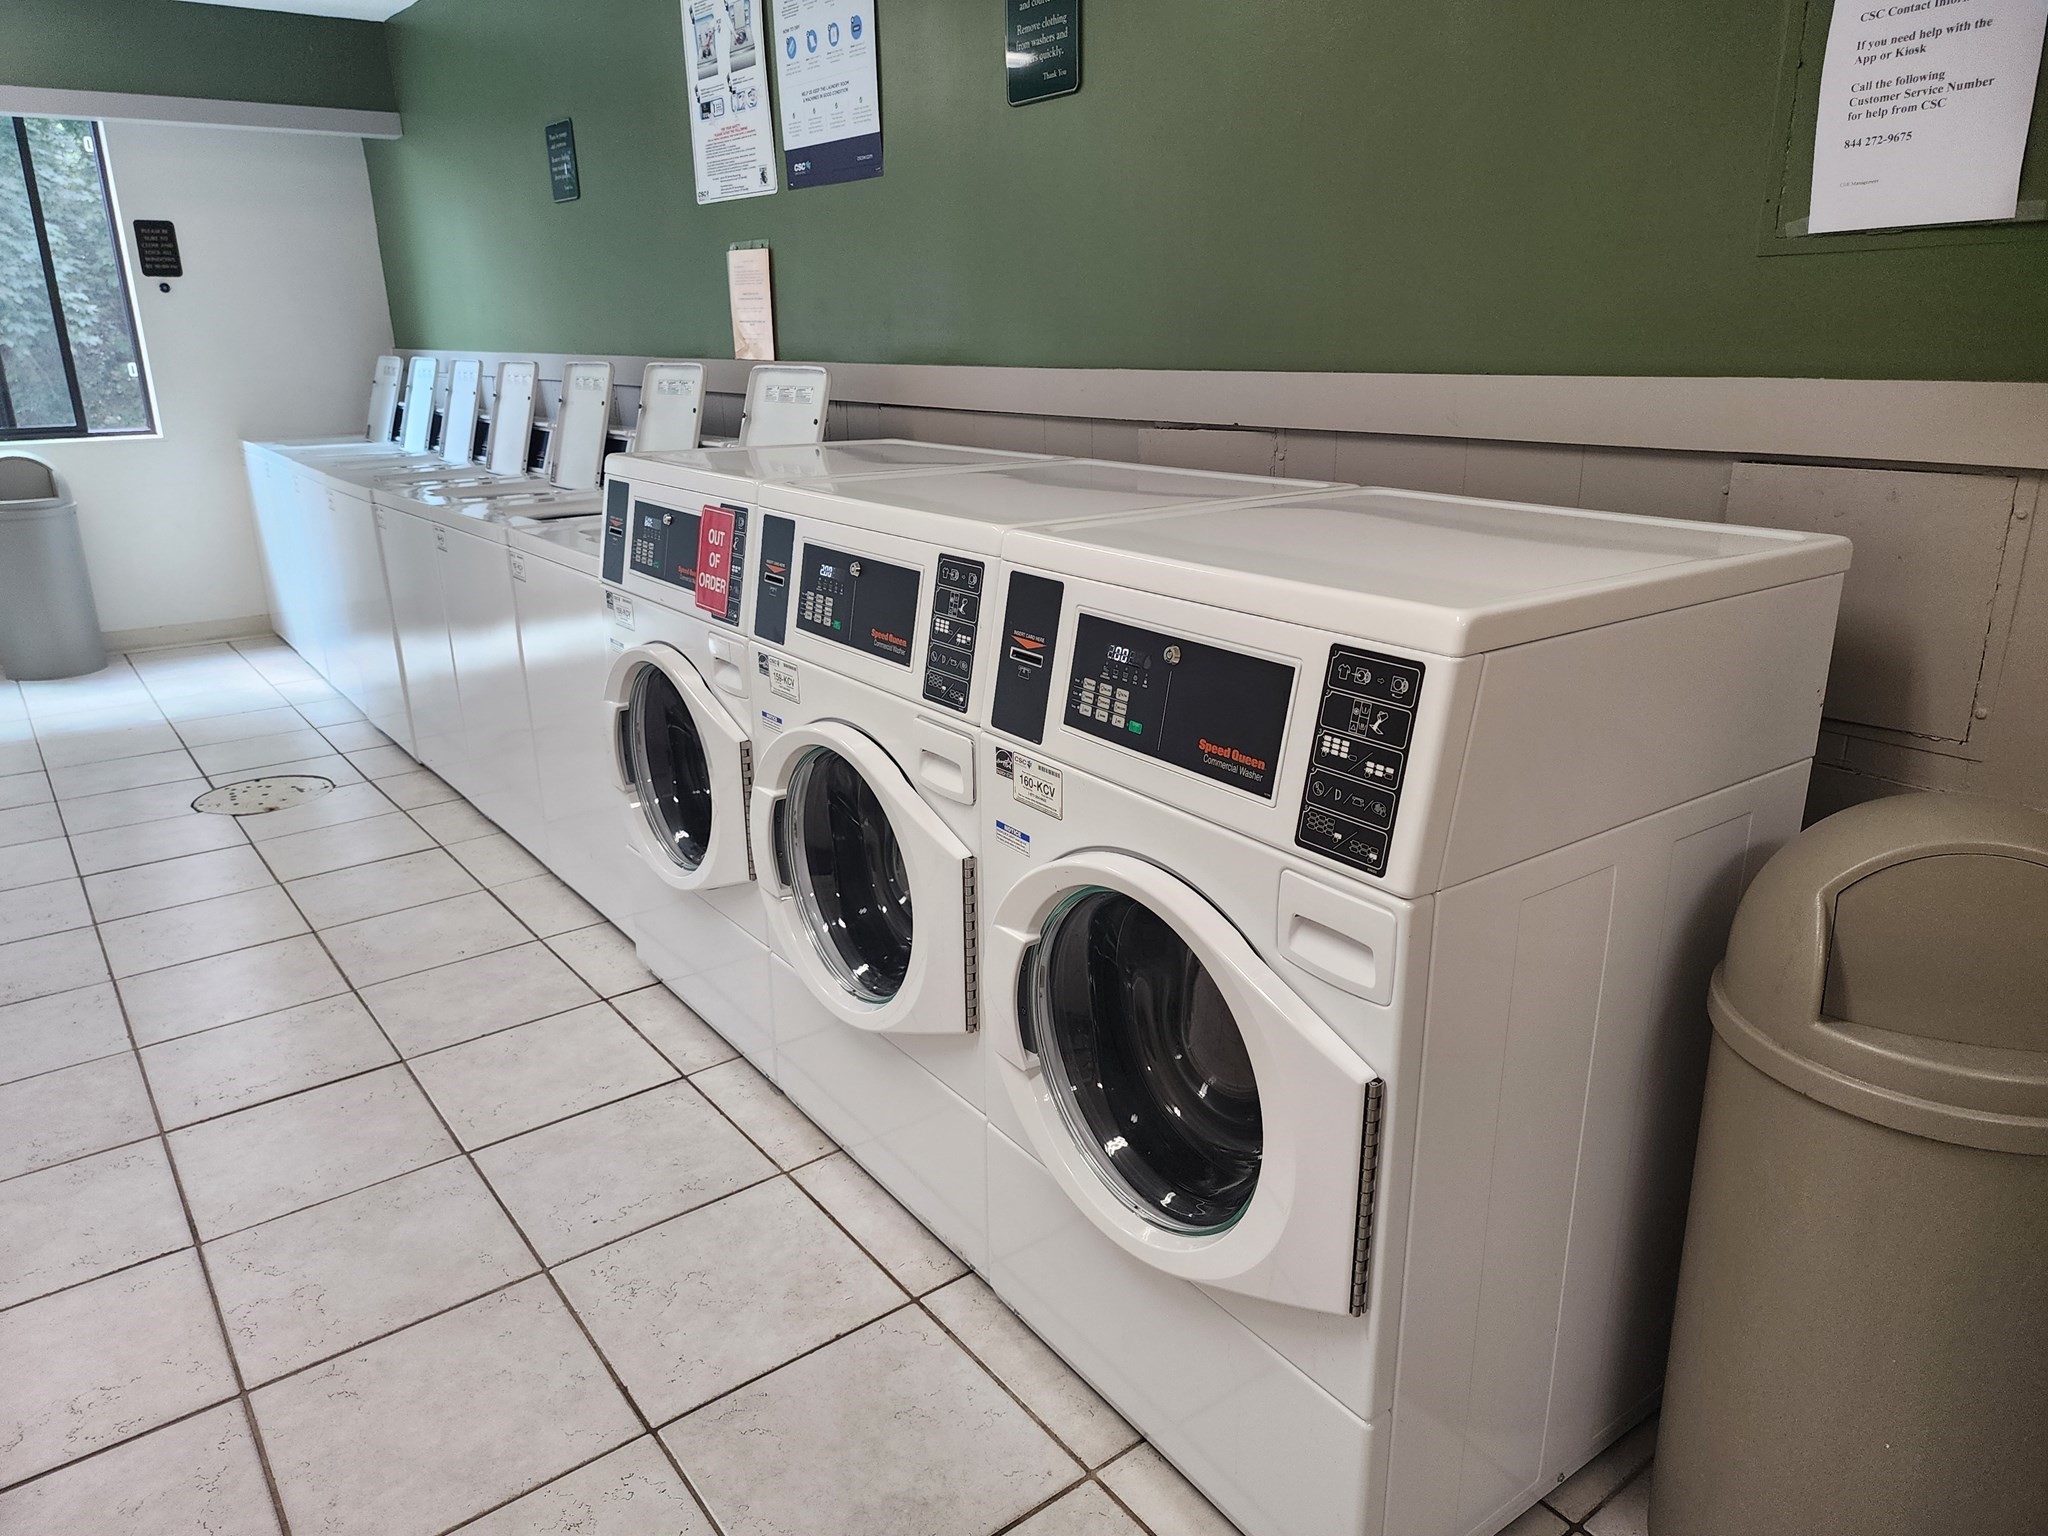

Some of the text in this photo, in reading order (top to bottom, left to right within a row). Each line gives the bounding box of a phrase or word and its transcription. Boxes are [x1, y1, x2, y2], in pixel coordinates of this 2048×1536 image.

[1860, 9, 1885, 22] CSC
[1888, 0, 1931, 16] Contact
[1016, 14, 1068, 36] Remove clothing
[1856, 18, 1993, 51] If you need help with the
[1016, 26, 1068, 52] from washers and
[1854, 44, 1926, 66] App or Kiosk
[1849, 78, 1996, 107] Customer Service Number
[1850, 70, 1946, 93] Call the following
[1848, 97, 1948, 121] for help from CSC
[1844, 130, 1912, 150] 844 272-9675
[794, 162, 806, 172] CSC
[708, 528, 725, 547] OUT
[709, 552, 721, 568] OF
[699, 572, 726, 595] ORDER
[871, 628, 907, 646] Speed Queen
[1015, 756, 1026, 766] CSC
[1198, 738, 1265, 770] Speed Queen
[1203, 754, 1264, 782] Commercial Washer
[1019, 774, 1055, 798] 160-KCV
